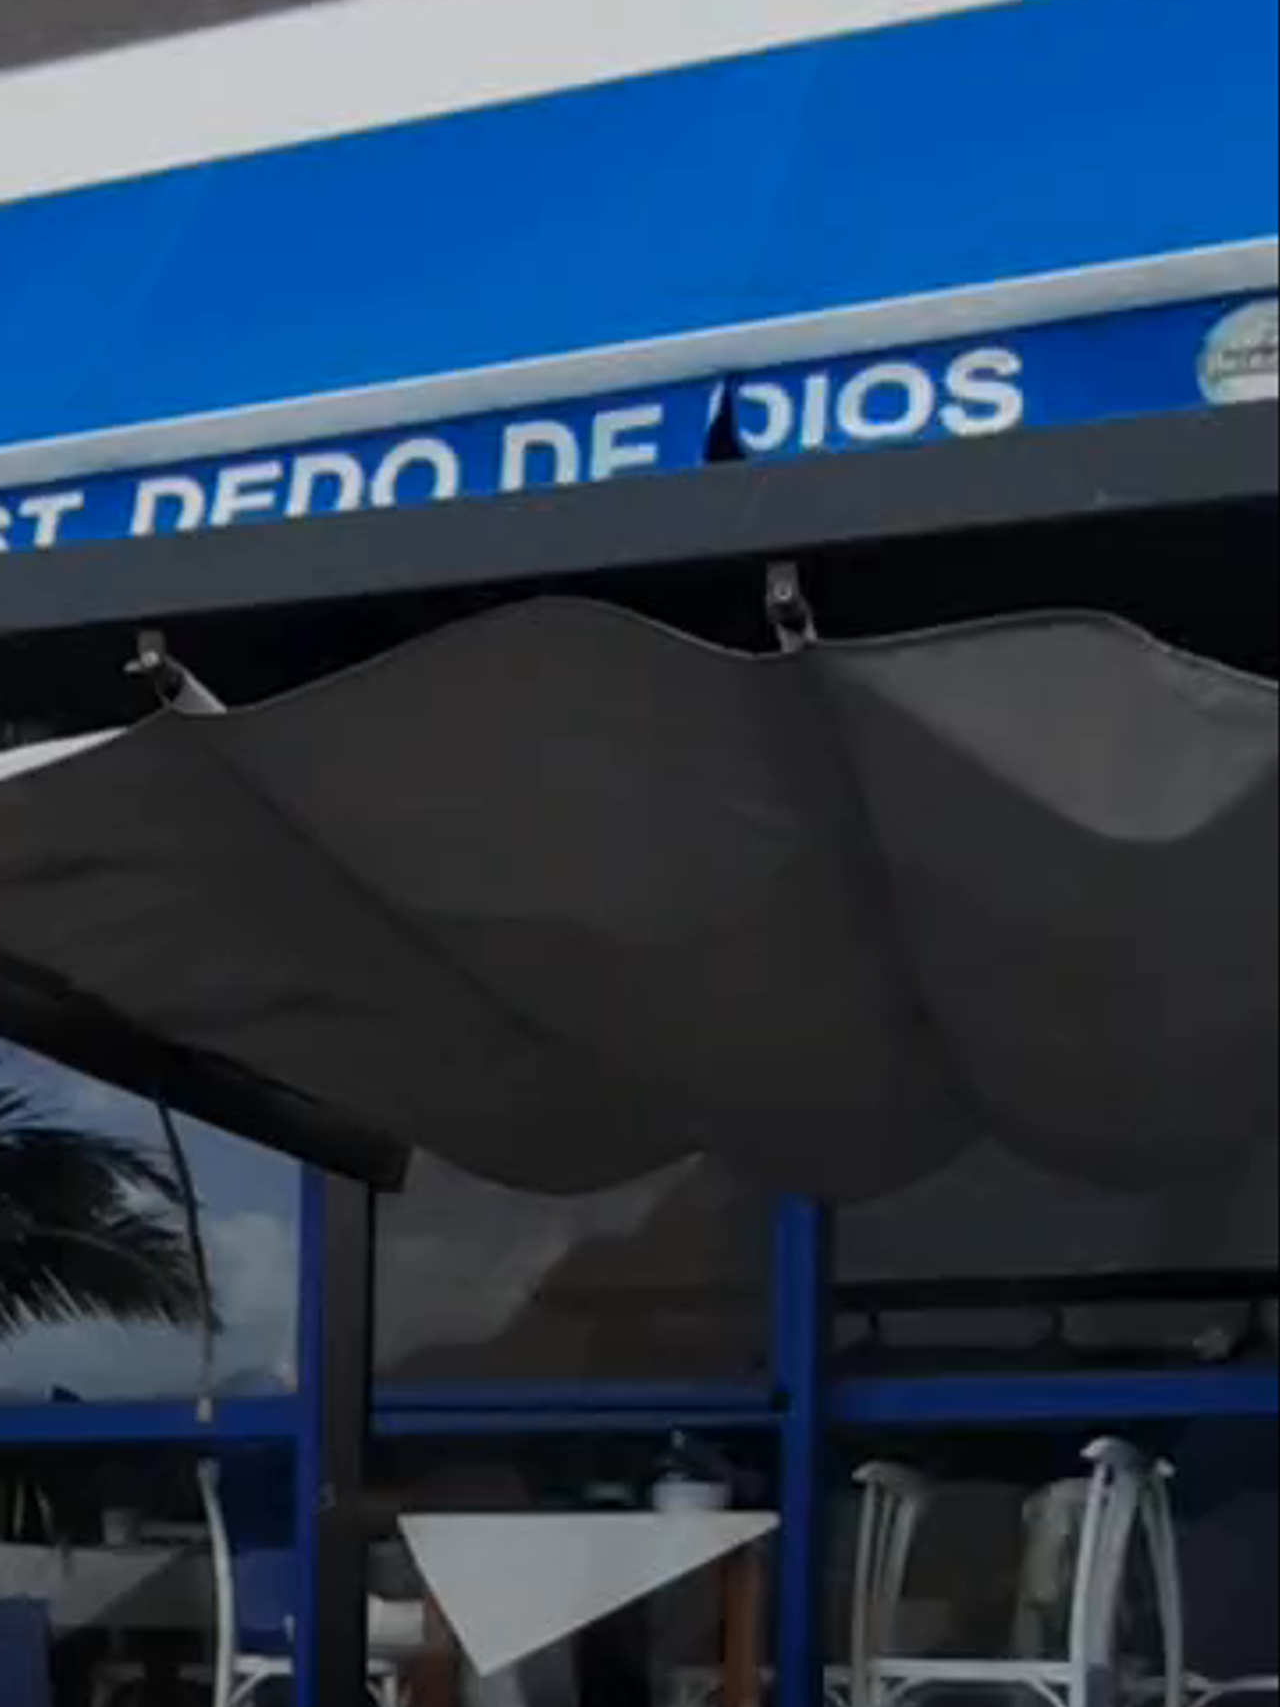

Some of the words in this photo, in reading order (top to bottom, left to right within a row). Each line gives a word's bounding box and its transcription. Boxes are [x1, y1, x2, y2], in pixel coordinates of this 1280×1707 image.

[129, 437, 461, 538] DEDO
[500, 404, 665, 493] DE
[704, 348, 1024, 453] DIOS
